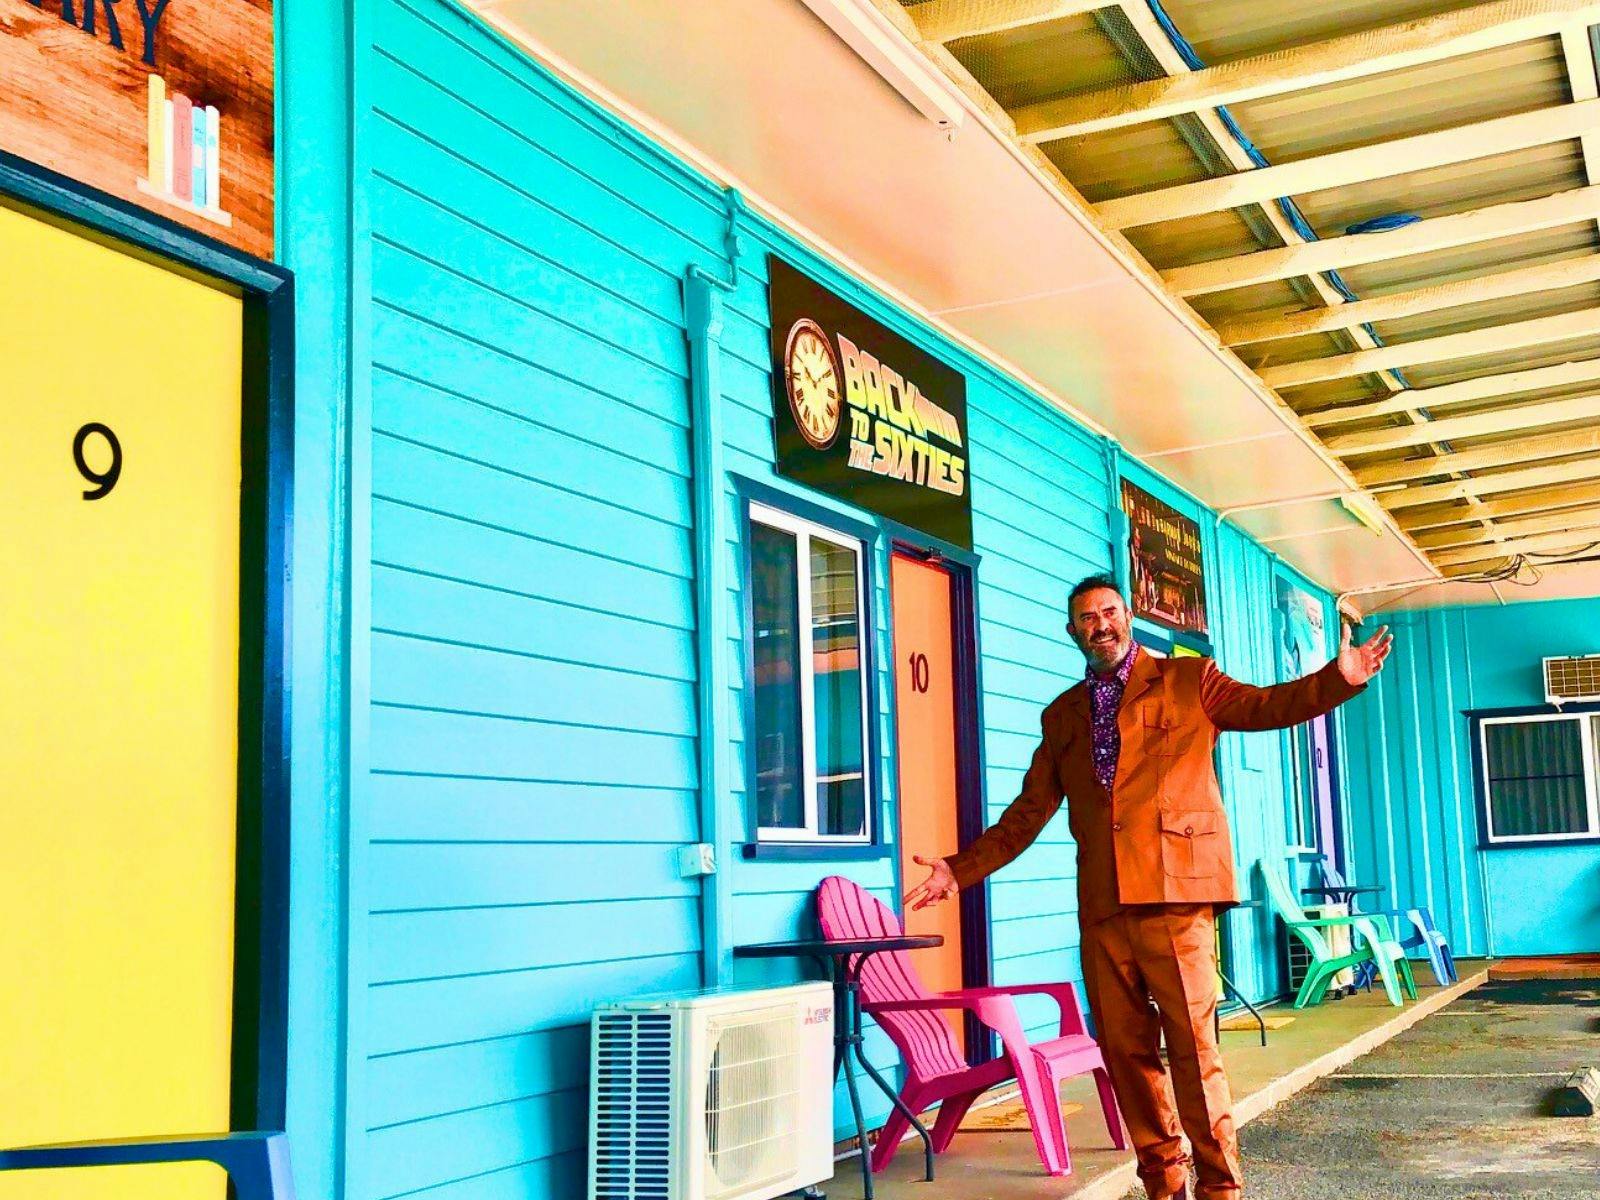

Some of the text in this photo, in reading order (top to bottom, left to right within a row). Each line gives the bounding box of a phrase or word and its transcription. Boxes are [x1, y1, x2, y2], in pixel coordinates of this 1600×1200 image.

[837, 331, 928, 441] BACK
[850, 407, 869, 442] TO
[72, 422, 122, 500] 9
[848, 438, 875, 472] THE
[872, 420, 965, 497] SIXTIES
[909, 651, 928, 693] 10
